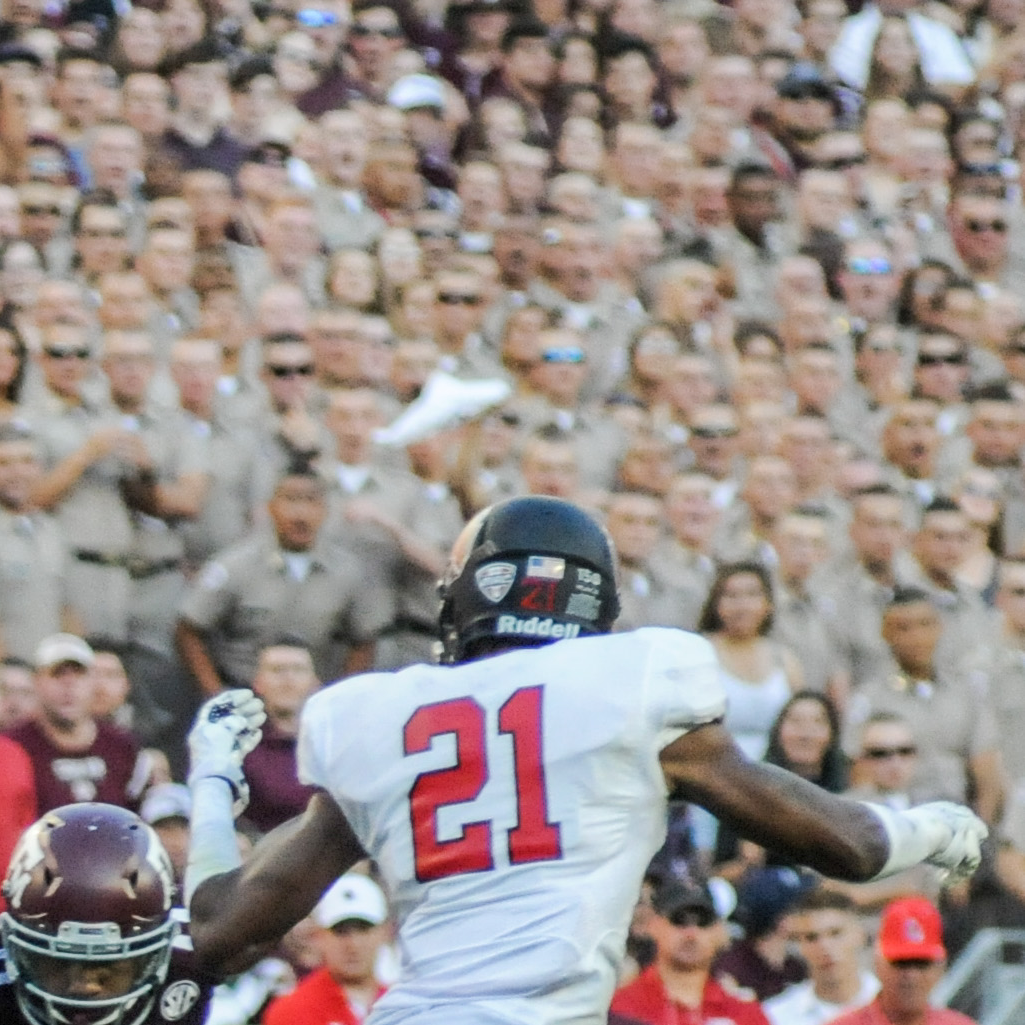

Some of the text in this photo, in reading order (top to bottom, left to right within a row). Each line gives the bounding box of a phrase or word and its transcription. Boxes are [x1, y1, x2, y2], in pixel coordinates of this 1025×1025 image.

[521, 577, 558, 611] 21
[497, 615, 581, 639] Riddell
[403, 683, 565, 885] 21
